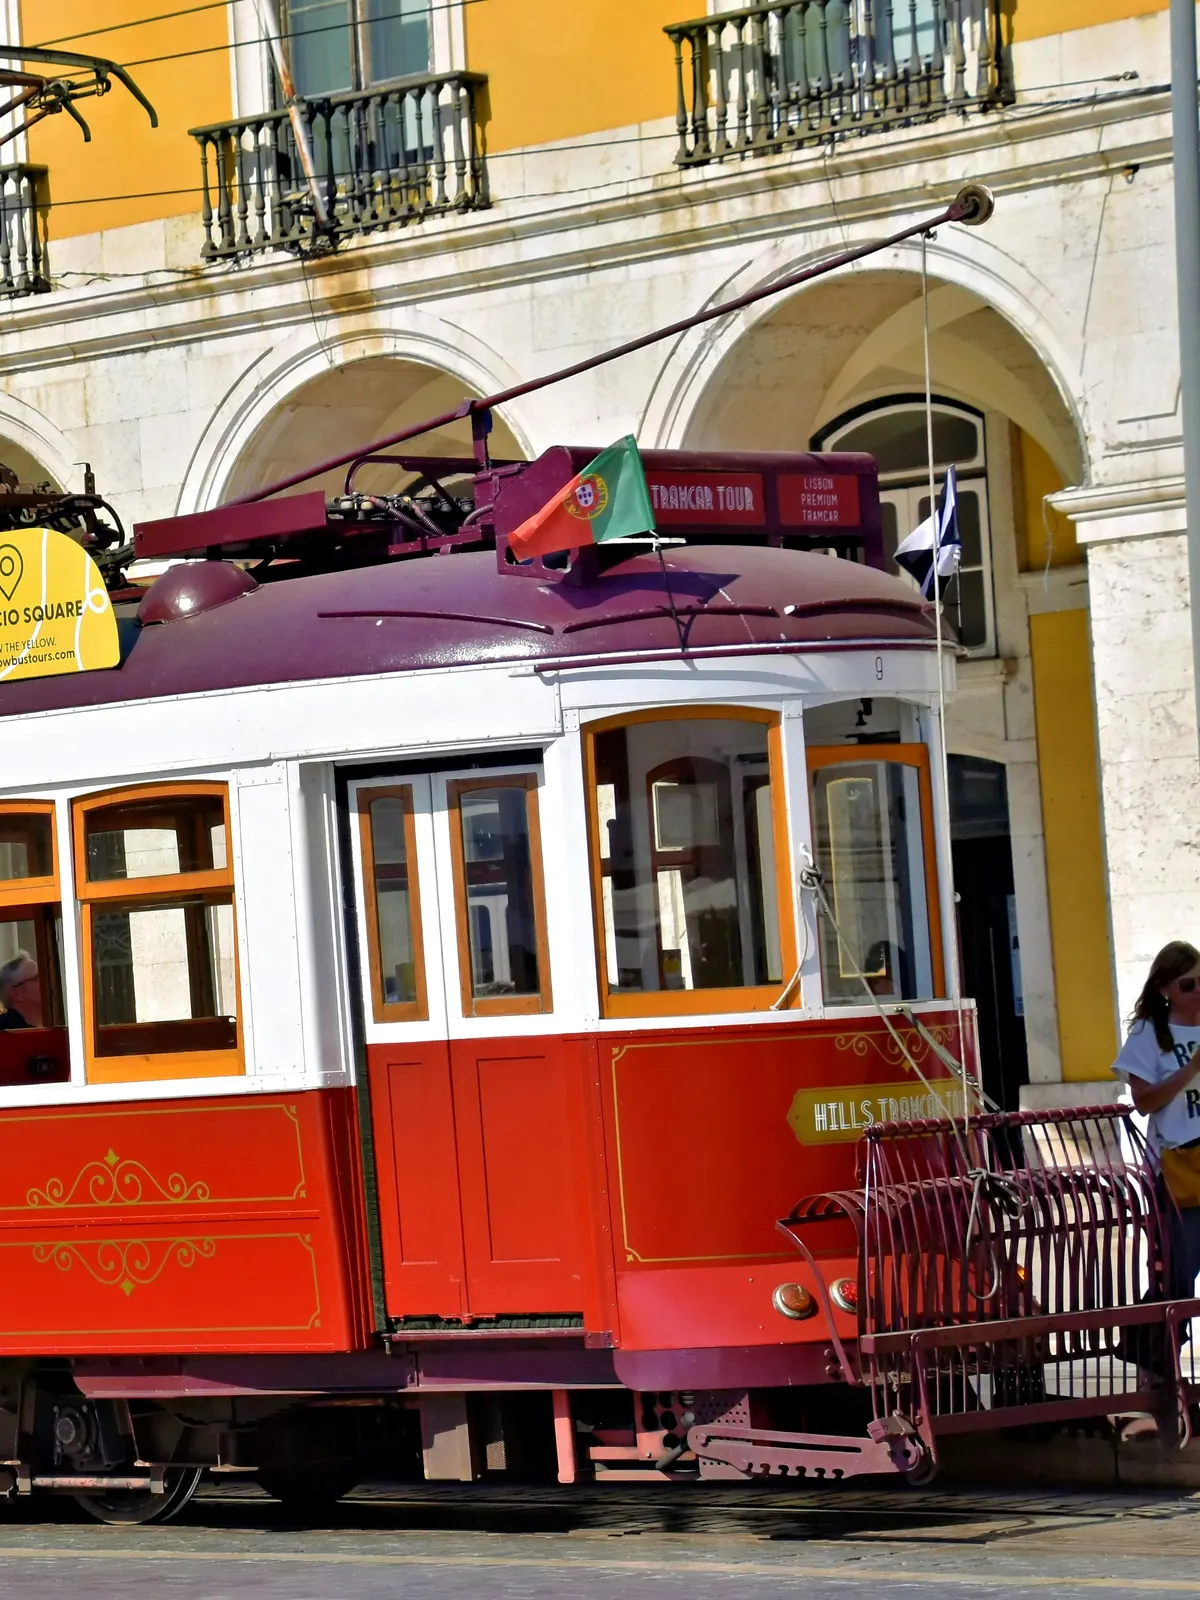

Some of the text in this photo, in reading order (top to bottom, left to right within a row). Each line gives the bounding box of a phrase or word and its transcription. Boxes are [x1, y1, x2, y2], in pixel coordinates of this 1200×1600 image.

[803, 478, 834, 489] LISBON
[651, 485, 755, 511] TRAMCAR TOUR
[800, 493, 838, 506] PREMIUM
[802, 509, 839, 522] TRAMCAR
[23, 600, 83, 624] SQUARE
[5, 641, 20, 653] THE
[874, 656, 884, 681] 9
[814, 1100, 875, 1132] HILLS
